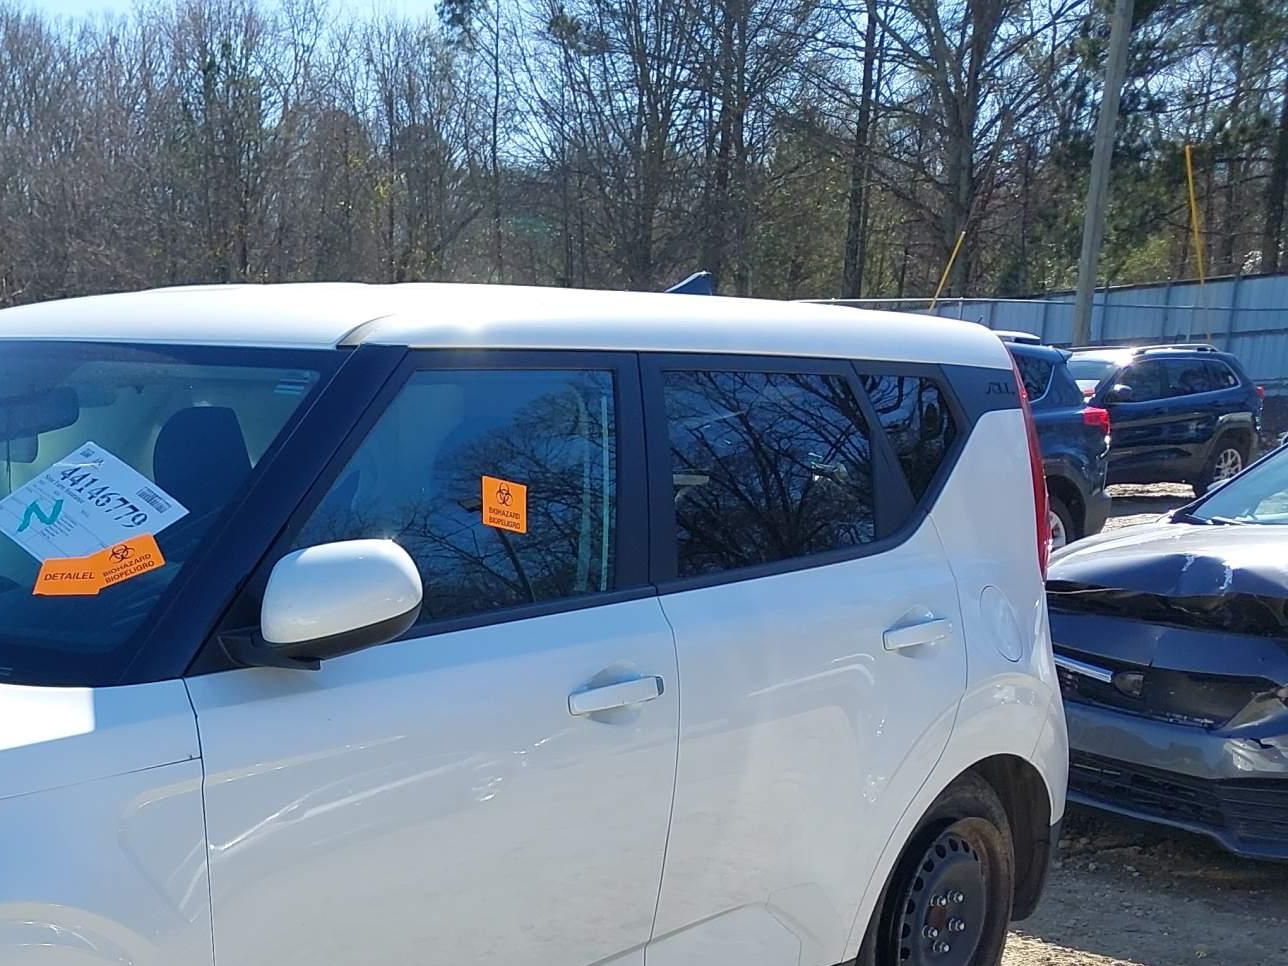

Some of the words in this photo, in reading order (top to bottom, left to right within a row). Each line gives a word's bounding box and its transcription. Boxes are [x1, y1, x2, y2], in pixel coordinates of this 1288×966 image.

[59, 466, 149, 528] 44146779
[489, 506, 521, 520] BIOHAZARD
[102, 553, 152, 577] BIOHAZARD
[104, 560, 155, 584] BIOPELIGRO
